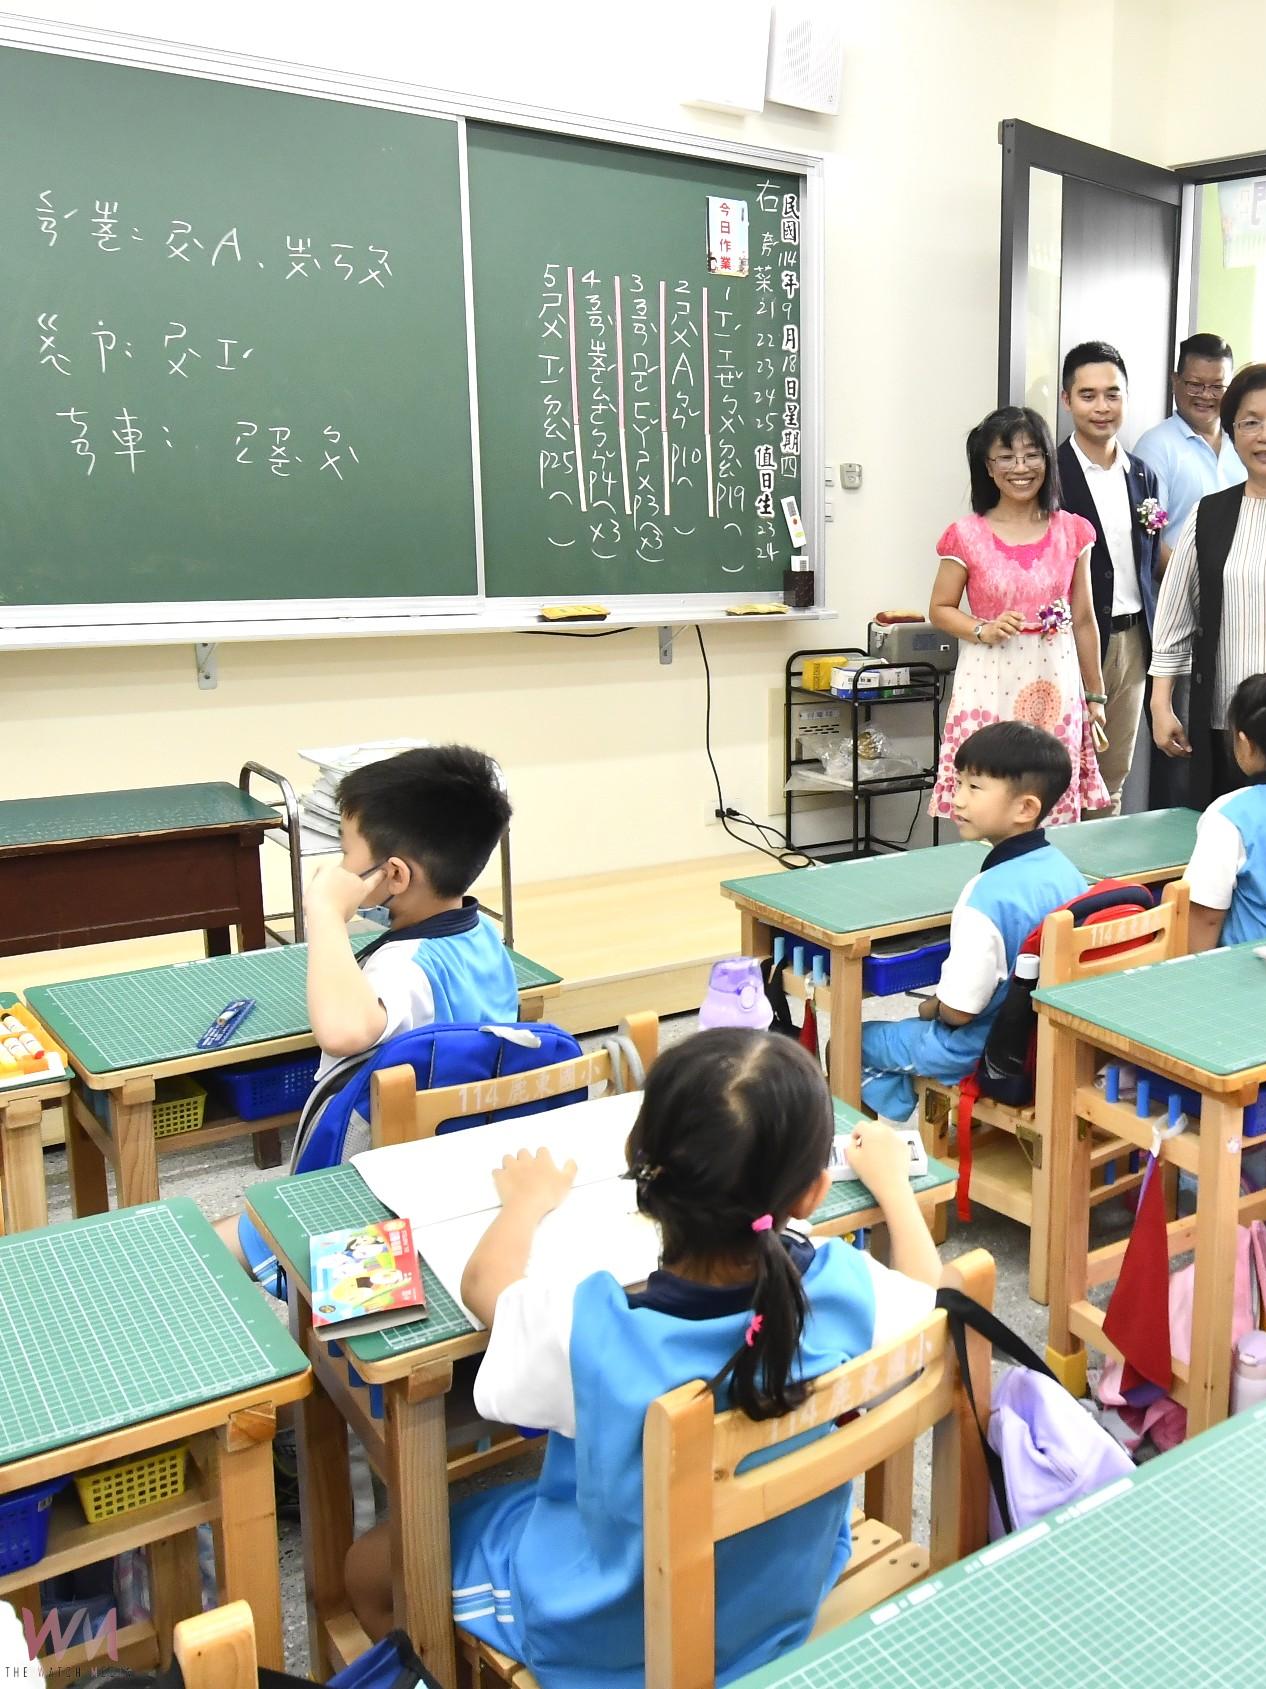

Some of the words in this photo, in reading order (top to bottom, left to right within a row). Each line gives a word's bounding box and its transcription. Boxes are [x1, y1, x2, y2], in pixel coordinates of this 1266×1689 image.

[756, 179, 781, 213] 右
[719, 201, 732, 271] 今日作業
[756, 333, 775, 347] 22
[756, 358, 775, 380] 23
[753, 388, 776, 406] 24
[755, 413, 779, 432] 25
[755, 445, 778, 518] 值日生
[458, 1082, 499, 1113] 114
